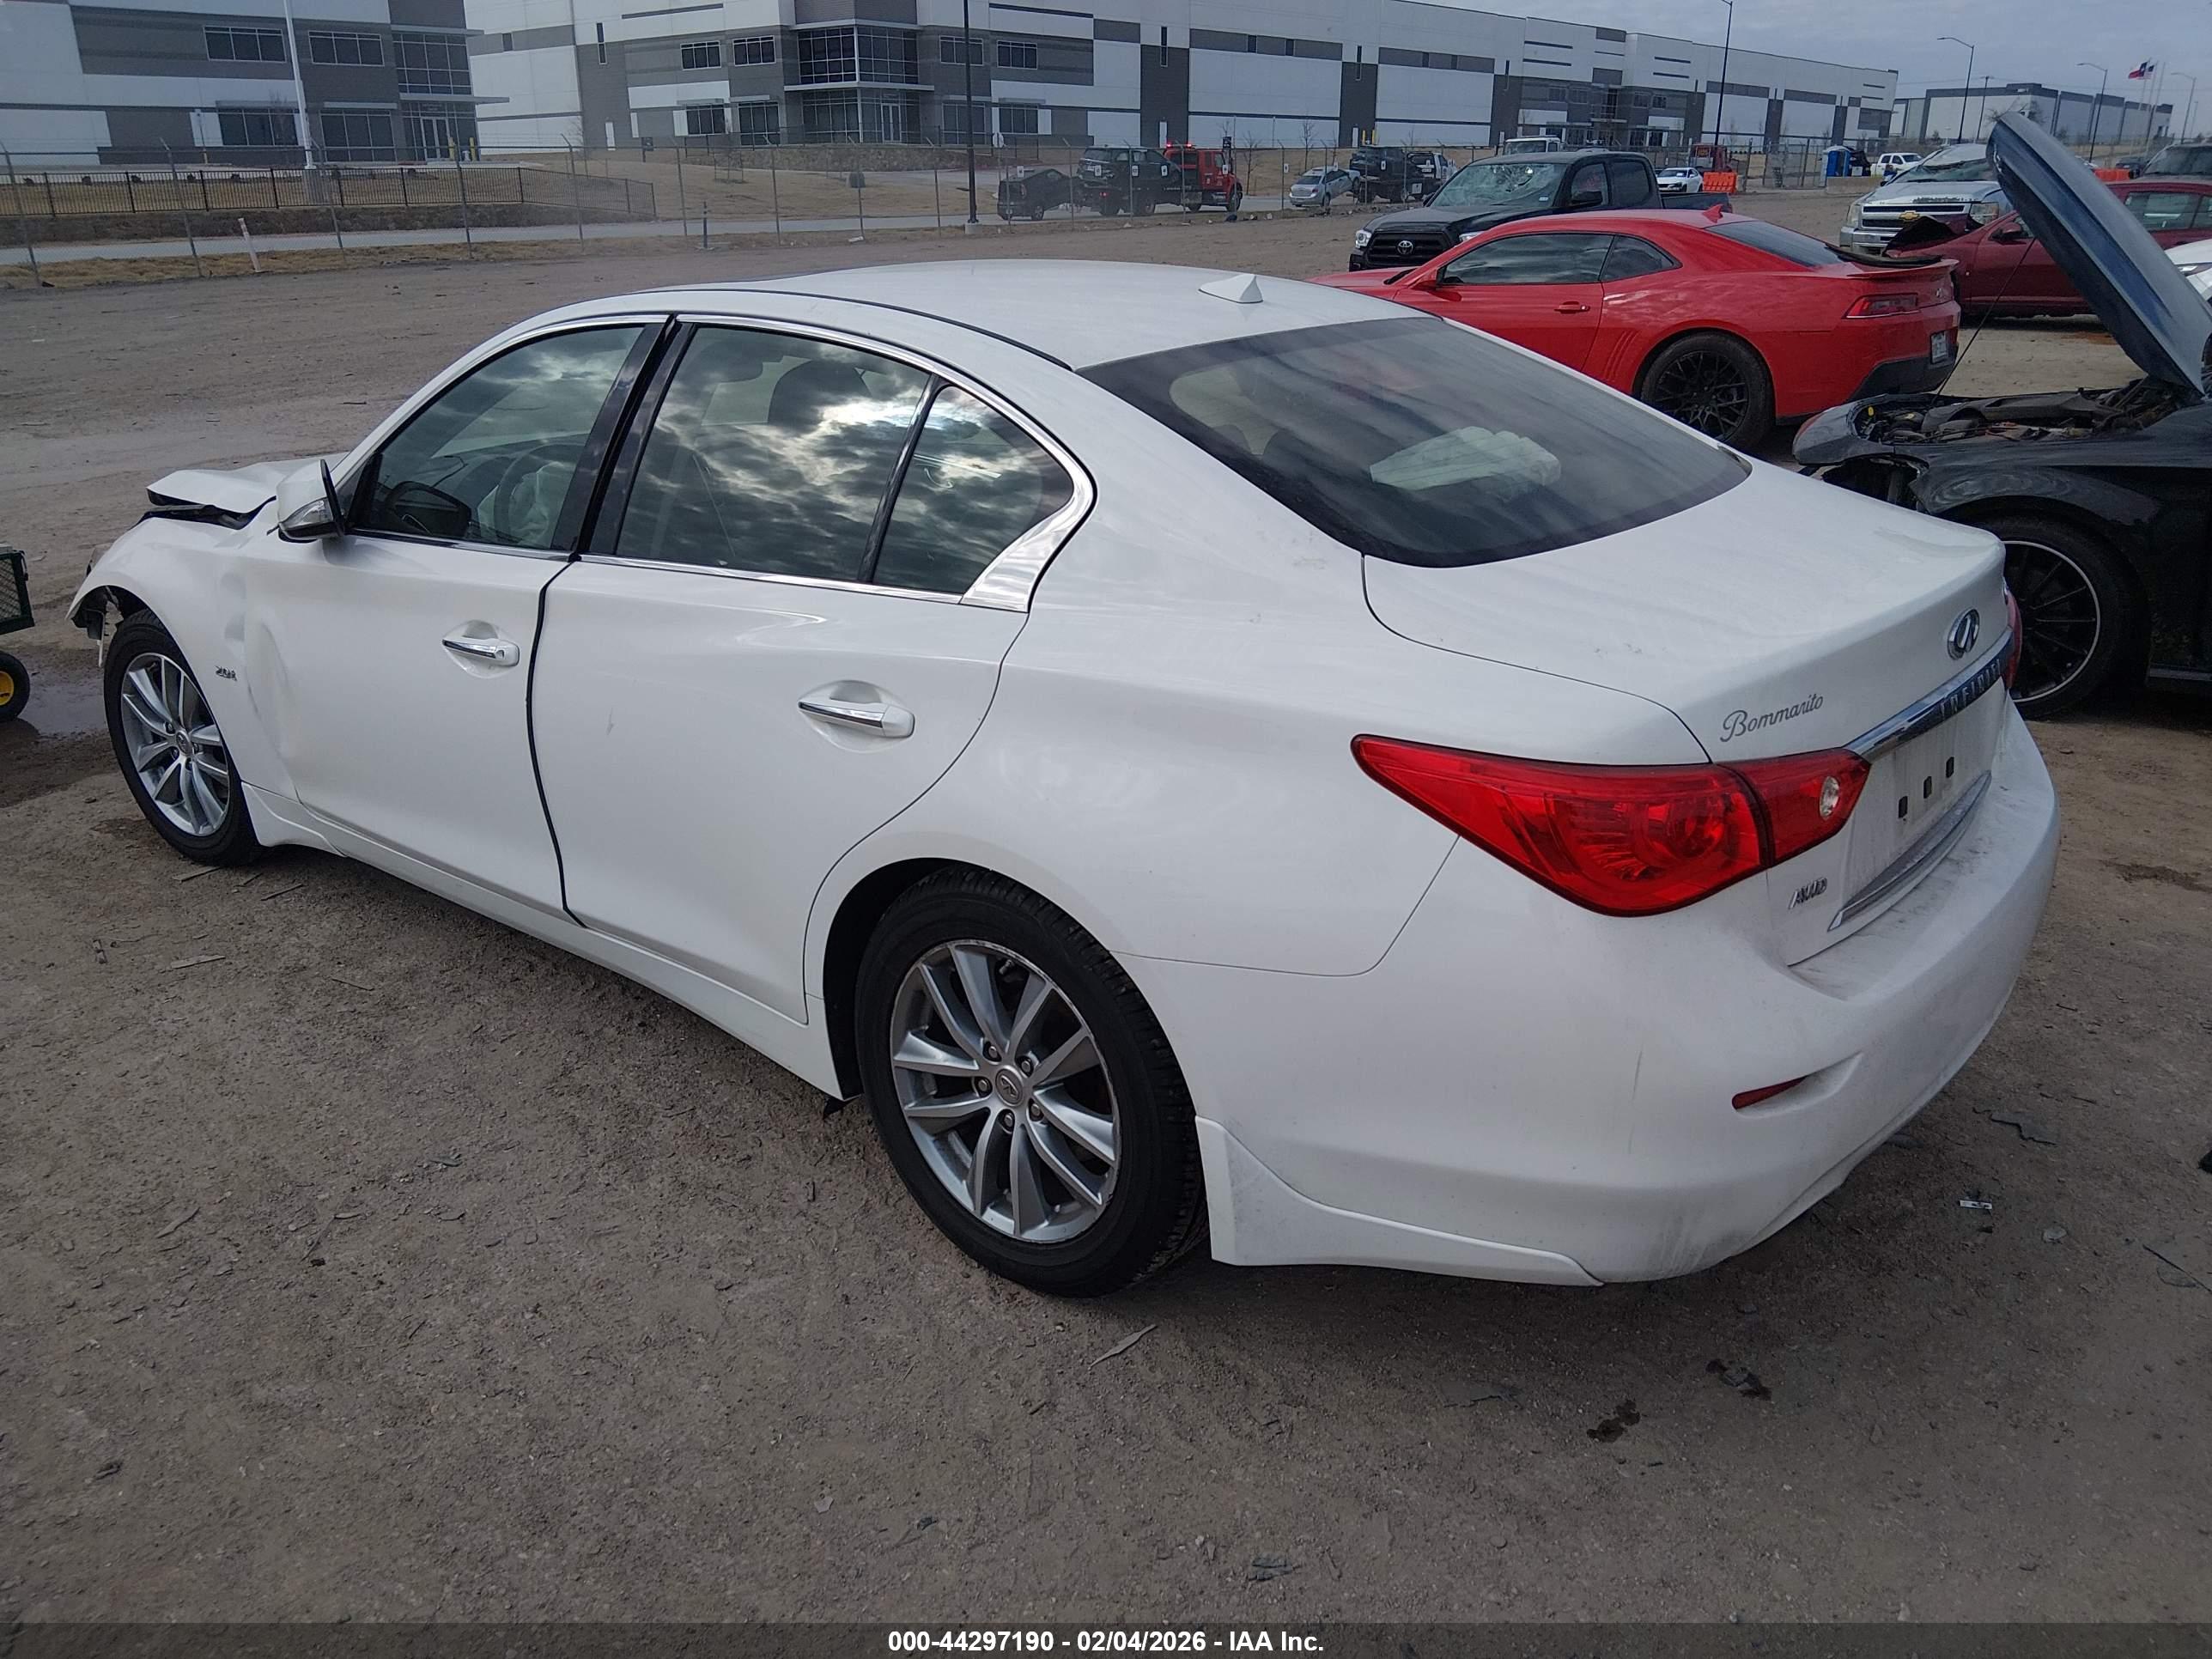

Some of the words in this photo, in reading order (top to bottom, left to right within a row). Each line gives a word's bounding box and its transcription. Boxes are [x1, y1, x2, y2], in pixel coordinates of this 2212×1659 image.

[1940, 658, 2001, 722] INFINITI
[1719, 693, 1824, 743] Bommarito
[1788, 877, 1828, 910] AWD
